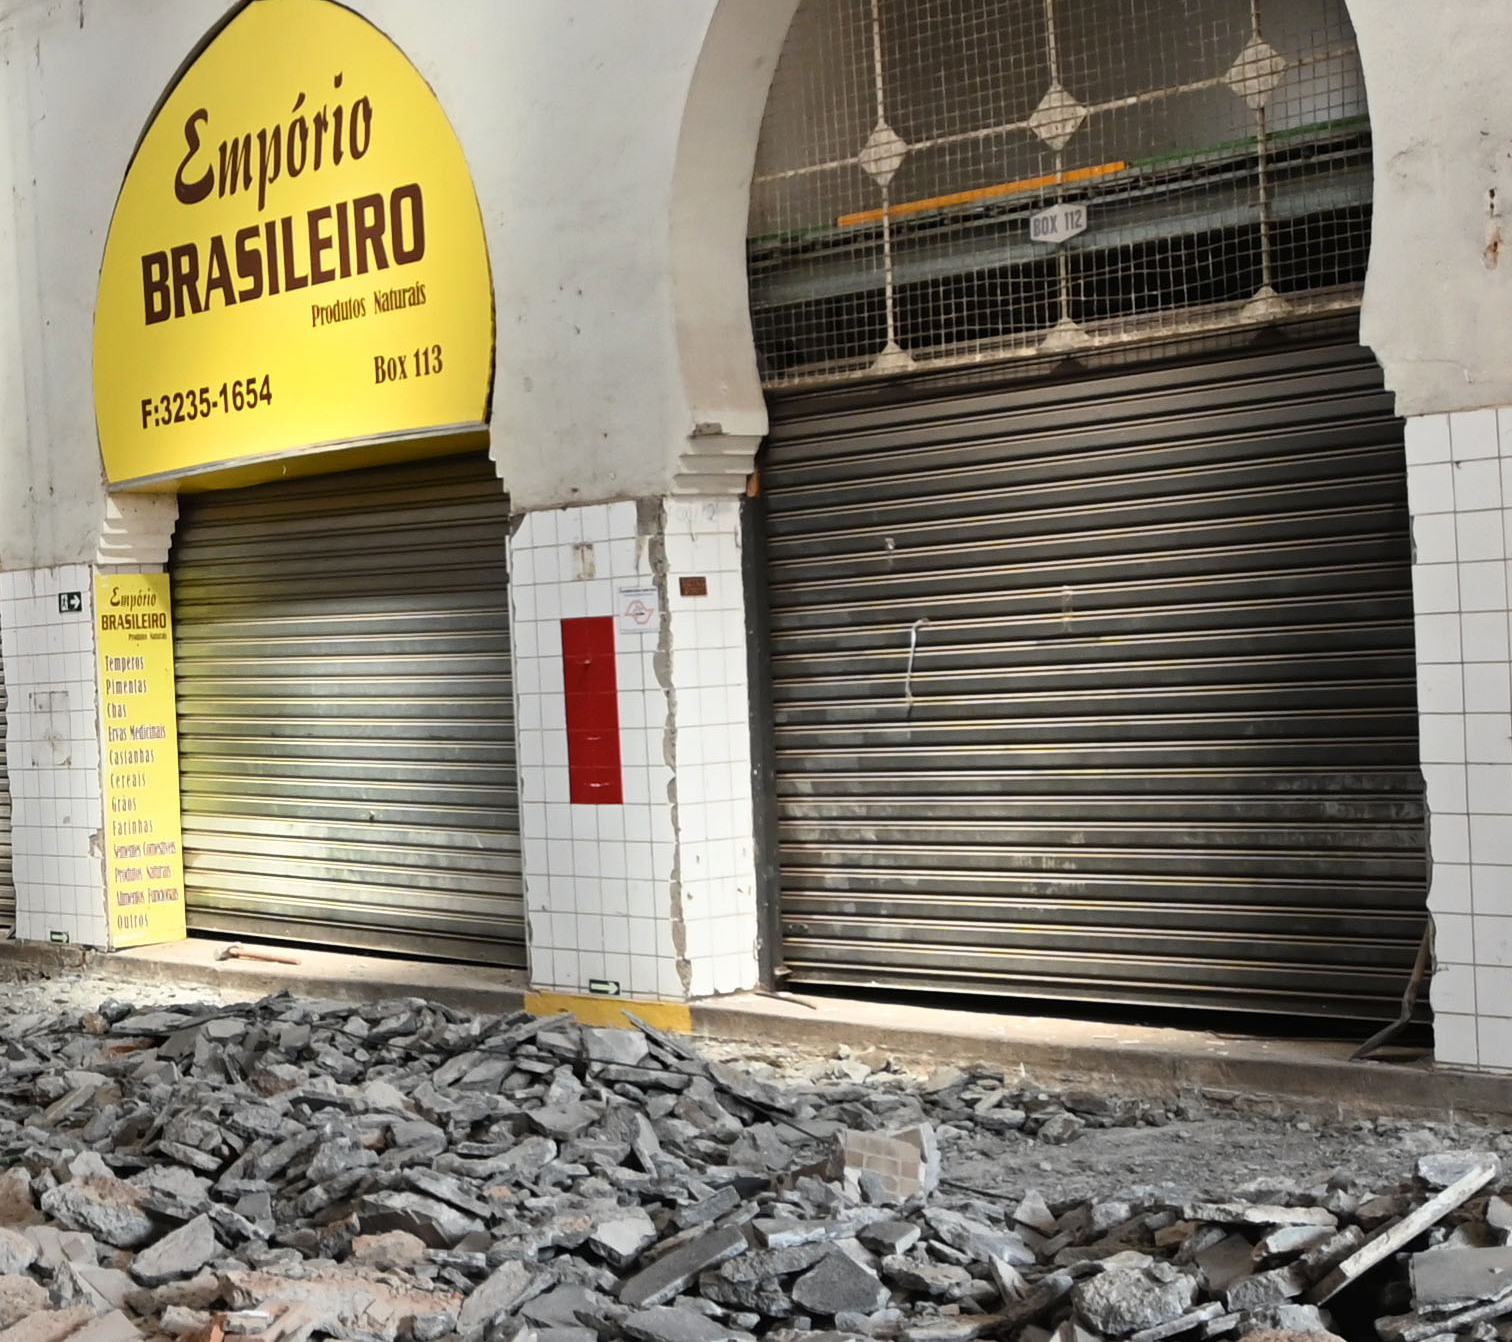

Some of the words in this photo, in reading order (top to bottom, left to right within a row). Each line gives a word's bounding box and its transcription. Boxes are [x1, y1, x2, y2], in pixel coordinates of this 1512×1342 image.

[174, 70, 373, 212] Empório
[1033, 213, 1058, 237] BOX
[1064, 209, 1083, 231] 112
[141, 182, 426, 326] BRASILEIRO
[311, 296, 367, 328] Produtos
[373, 280, 427, 315] Naturais
[373, 355, 408, 385] Box
[413, 344, 444, 378] 113
[141, 373, 273, 430] F:3235-1654
[110, 586, 157, 612] Empório
[101, 612, 167, 631] BRASILEIRO
[105, 655, 144, 673] Temperos
[106, 679, 147, 695] Pimentas
[108, 725, 127, 742] Ervas
[129, 723, 167, 740] Medicinais
[109, 747, 155, 766] Castanhas
[110, 771, 146, 789] Cereais
[113, 819, 153, 837] Farinhas
[117, 912, 149, 930] Outros
